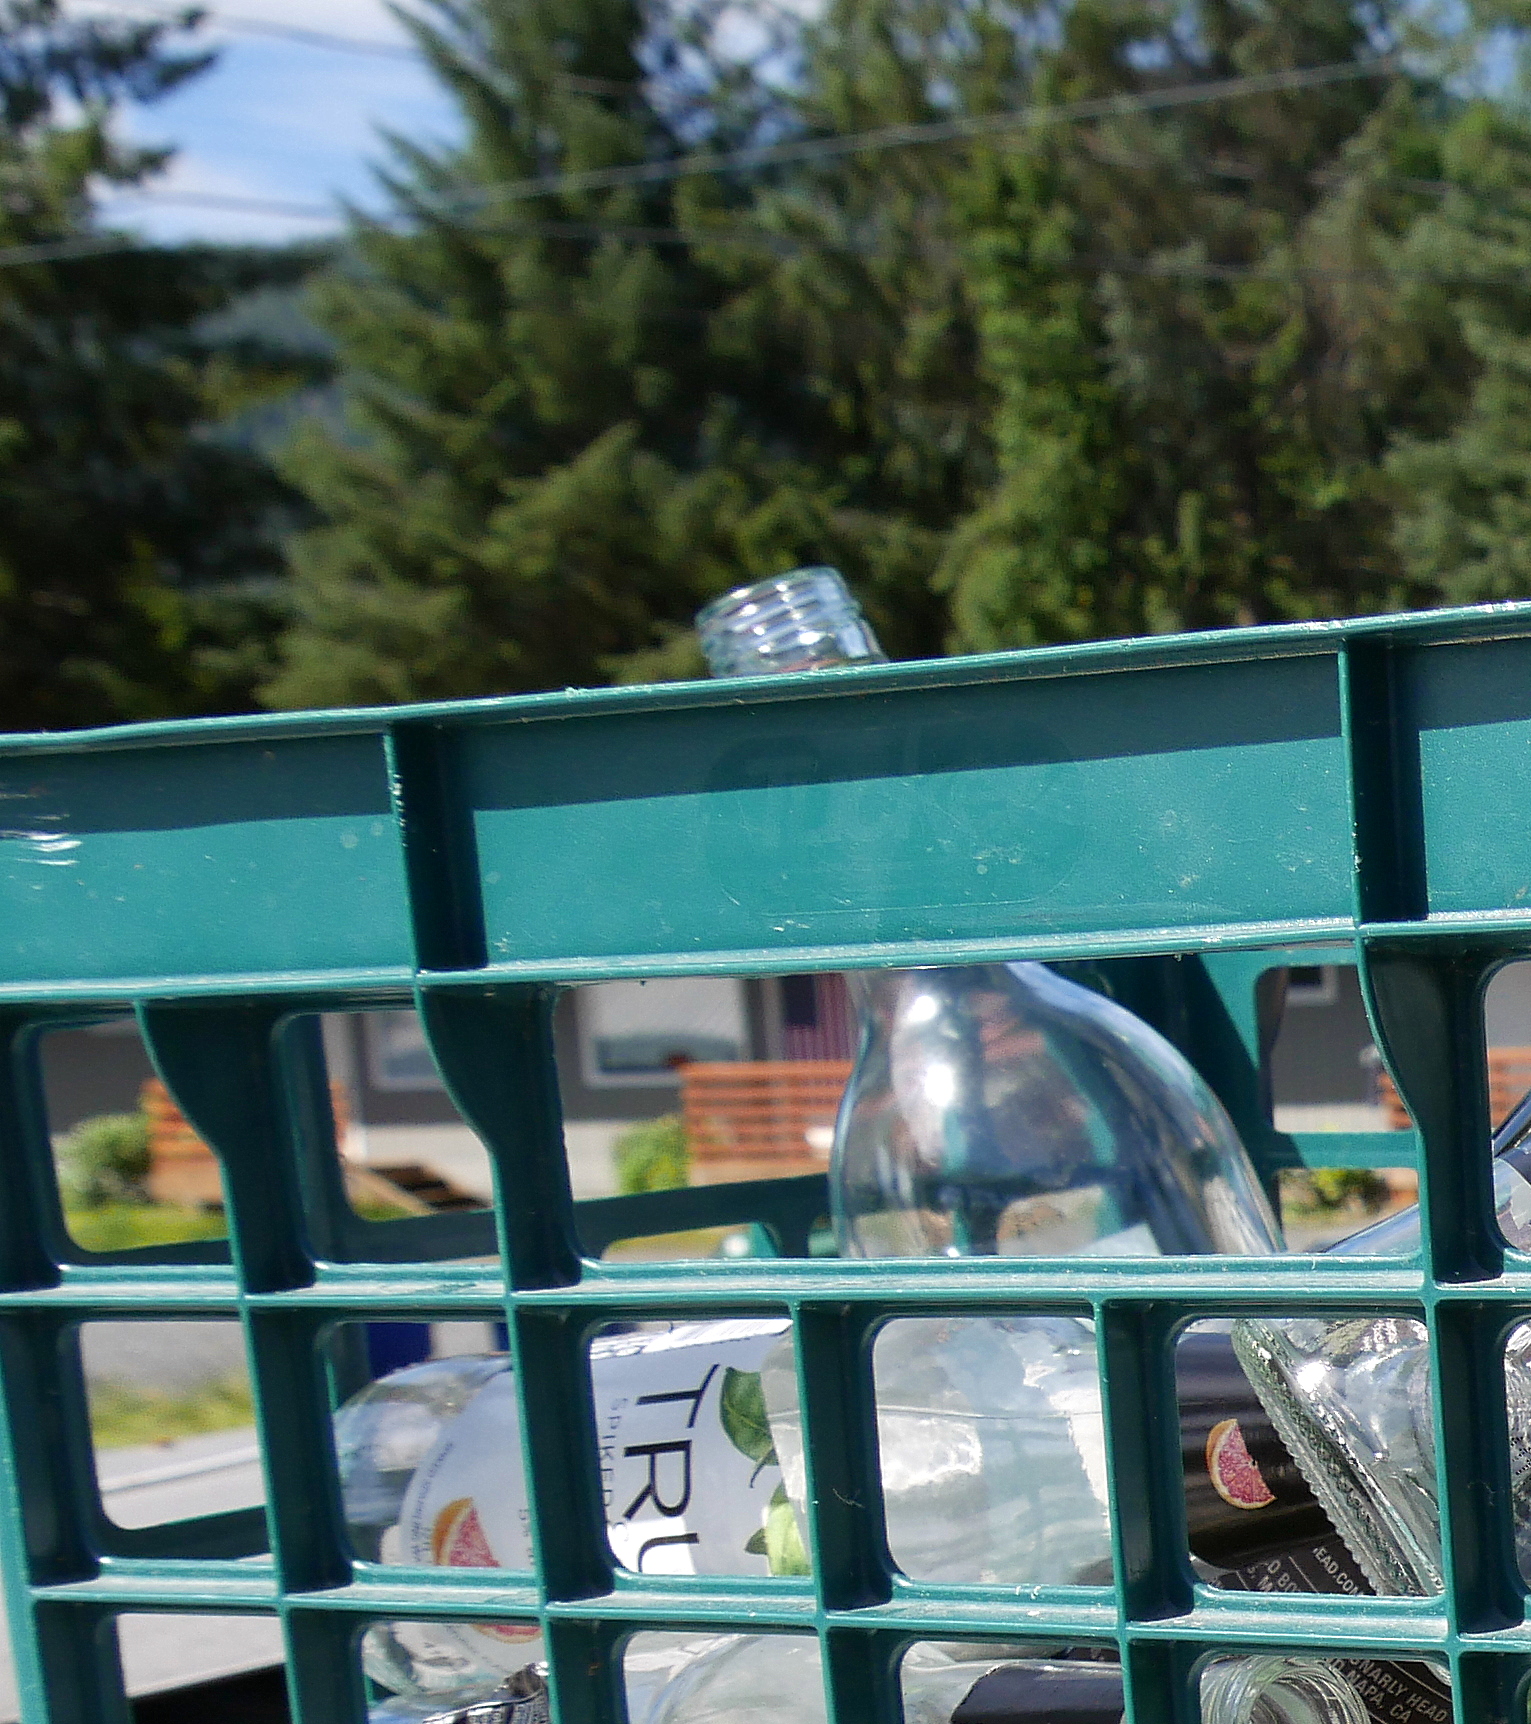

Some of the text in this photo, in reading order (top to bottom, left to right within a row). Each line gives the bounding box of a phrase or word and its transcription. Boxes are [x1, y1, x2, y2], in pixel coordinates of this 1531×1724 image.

[623, 1363, 721, 1572] TRU
[1347, 1671, 1412, 1724] NAPA, CA
[1407, 1694, 1447, 1722] HEAD
